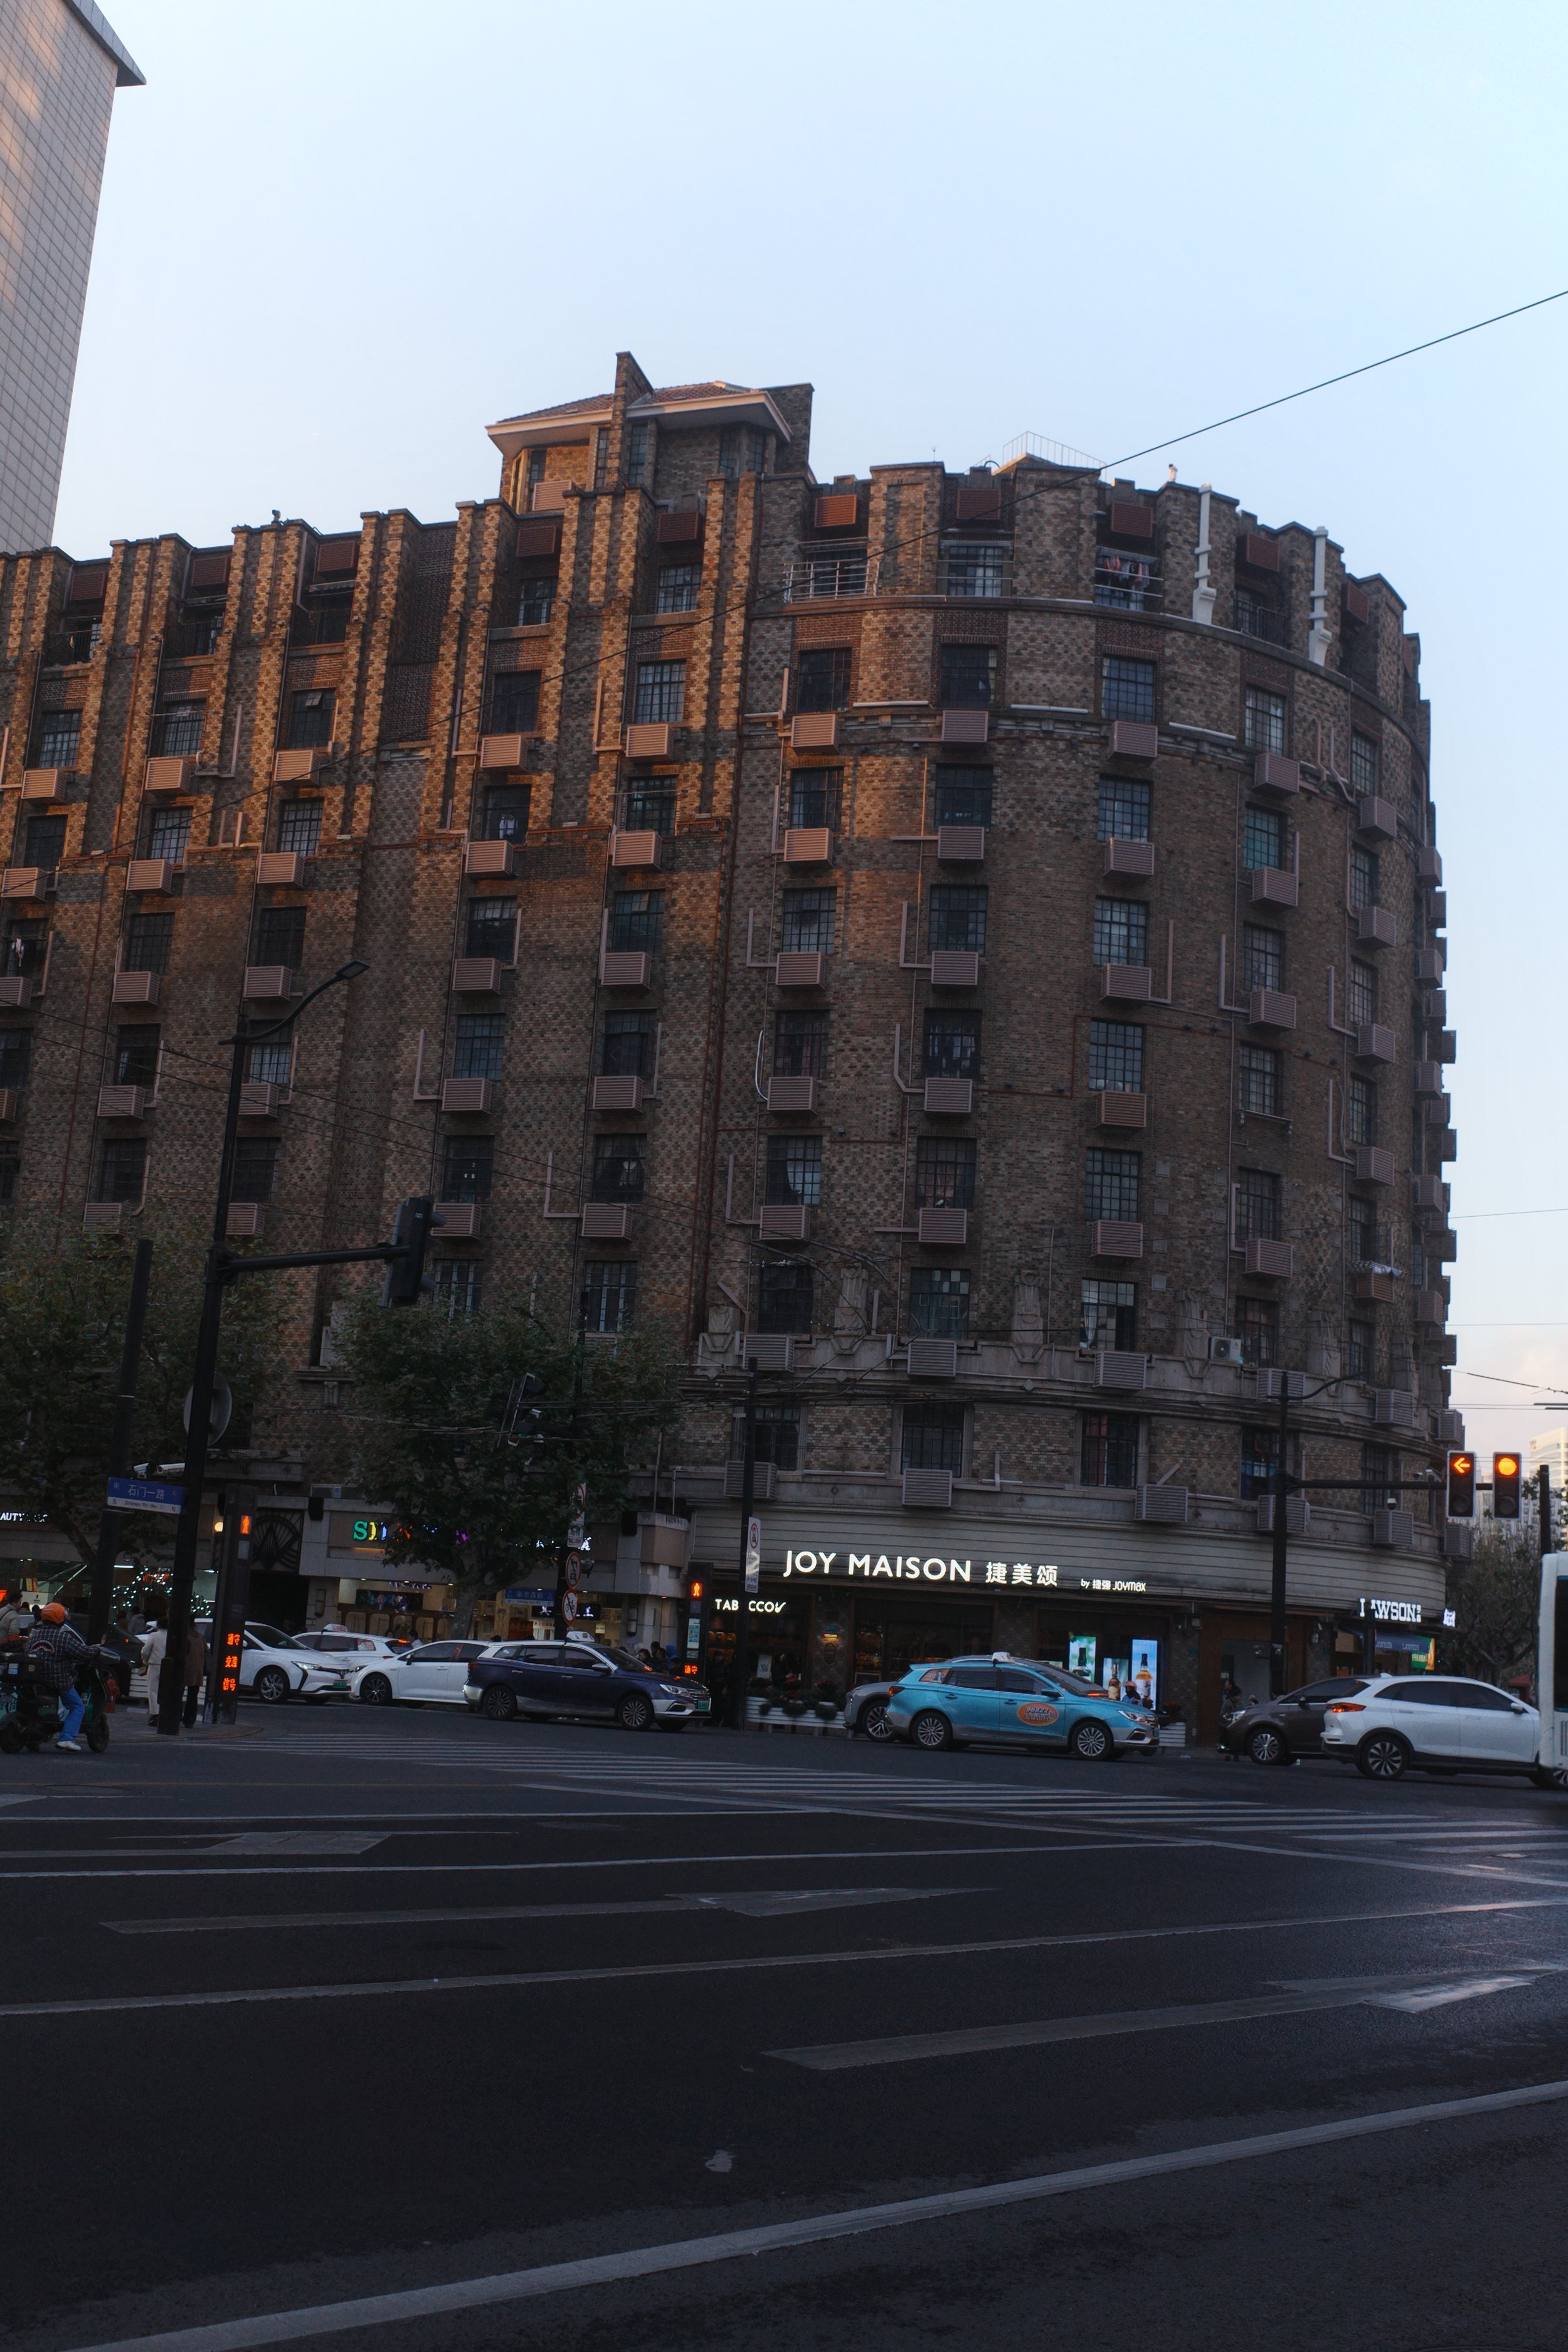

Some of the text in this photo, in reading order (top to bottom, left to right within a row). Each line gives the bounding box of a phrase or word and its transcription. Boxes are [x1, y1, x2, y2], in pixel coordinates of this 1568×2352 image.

[127, 1484, 165, 1500] 石门一路
[0, 1512, 25, 1522] AUTY
[783, 1550, 837, 1577] JOY
[849, 1554, 971, 1582] MAISON
[985, 1562, 1058, 1587] 捷美颂
[1081, 1578, 1090, 1589] by
[715, 1599, 775, 1613] TABCCO
[225, 1655, 238, 1668] 交通
[223, 1678, 236, 1691] 信号
